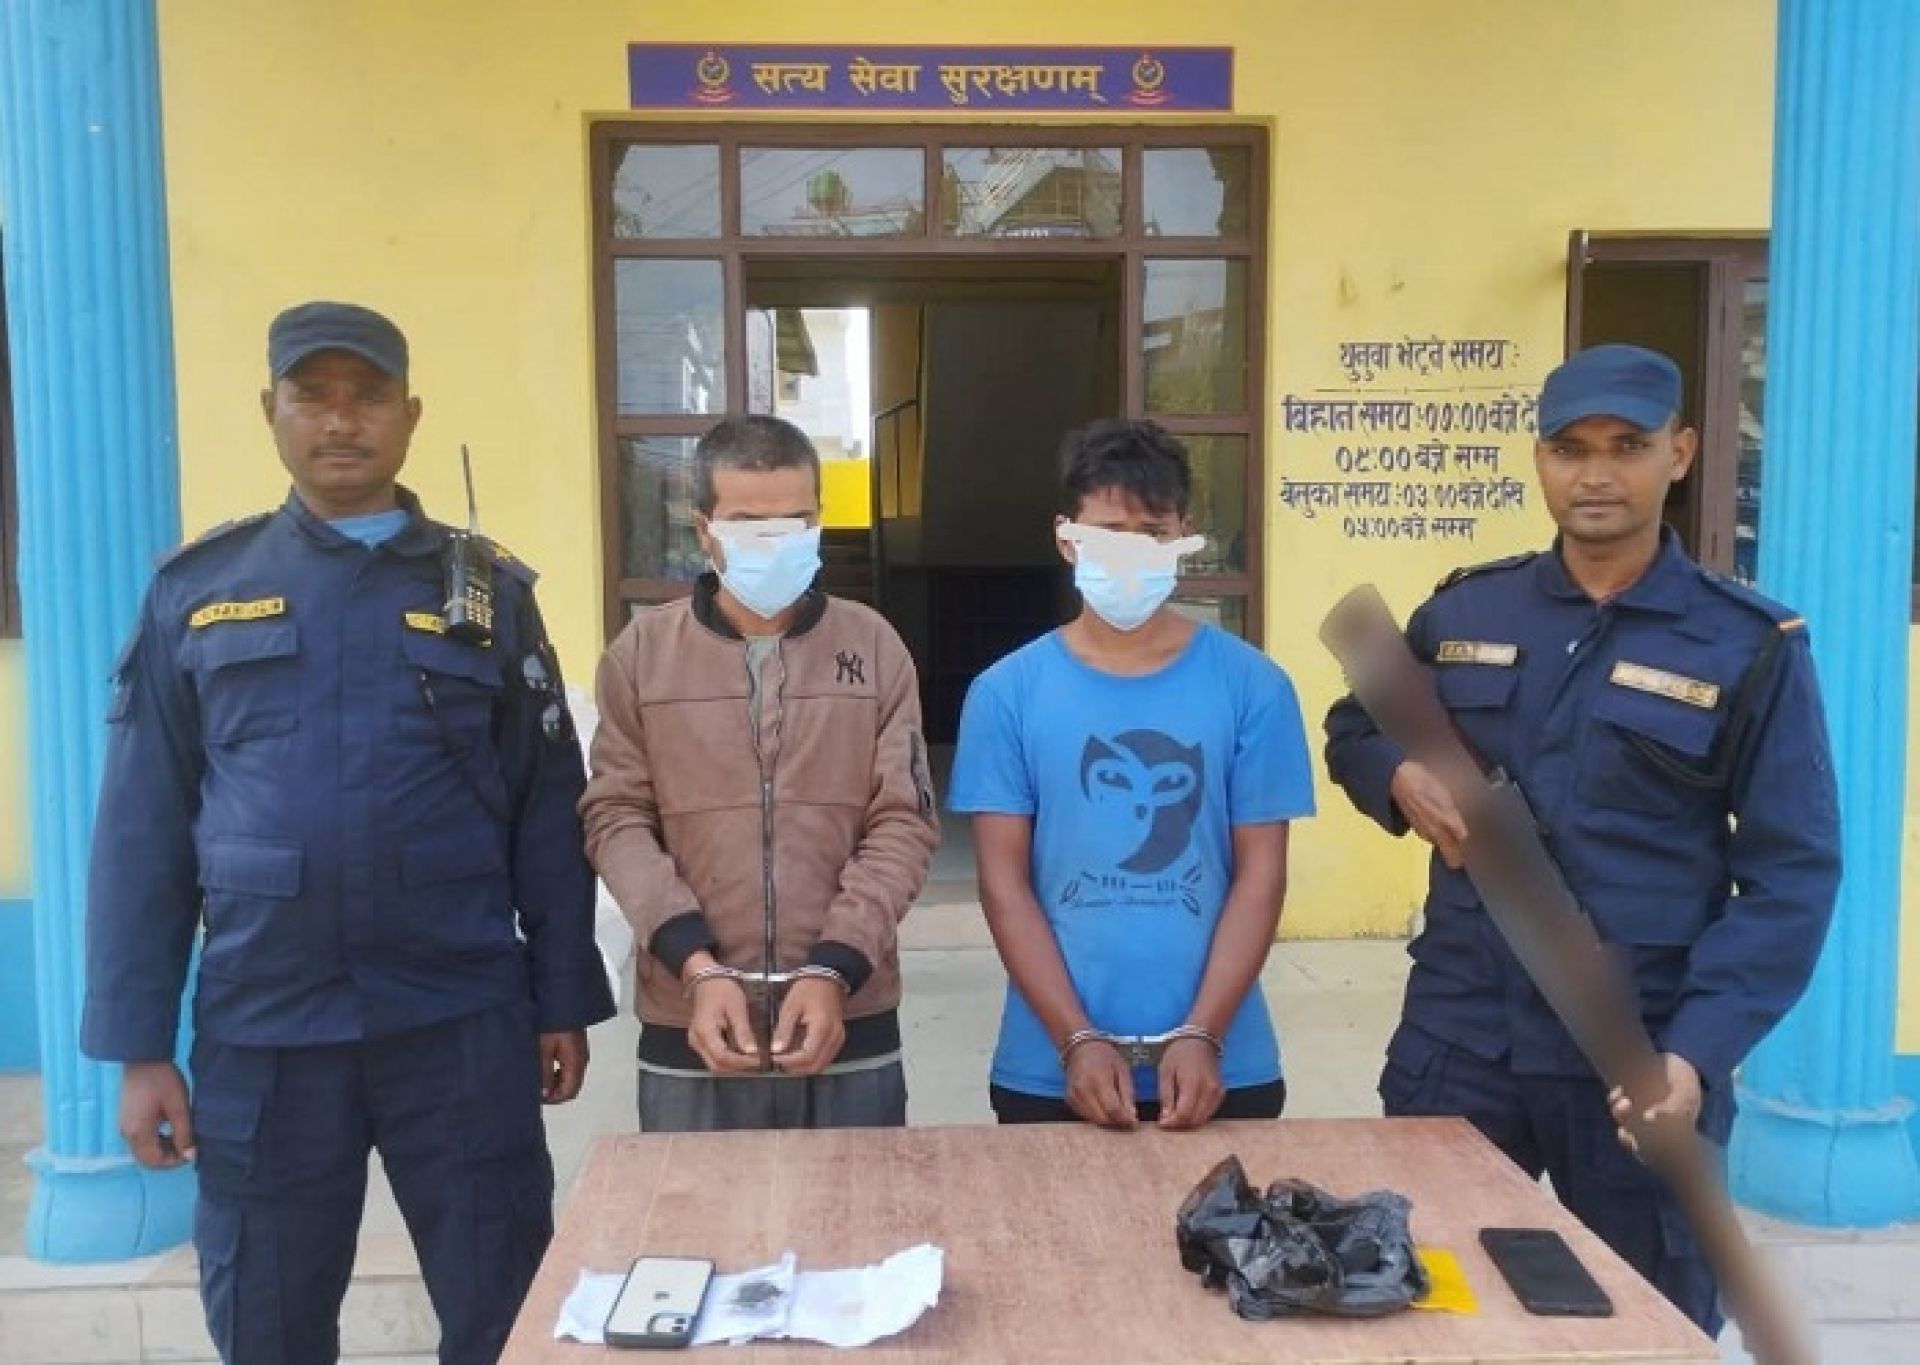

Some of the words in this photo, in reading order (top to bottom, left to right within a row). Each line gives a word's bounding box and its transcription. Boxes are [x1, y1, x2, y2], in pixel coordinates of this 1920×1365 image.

[751, 61, 829, 95] सत्य
[849, 57, 921, 95] सेवा
[939, 62, 1106, 103] सुरक्षणम्
[1281, 394, 1358, 432] बिहान
[833, 650, 866, 686] NY
